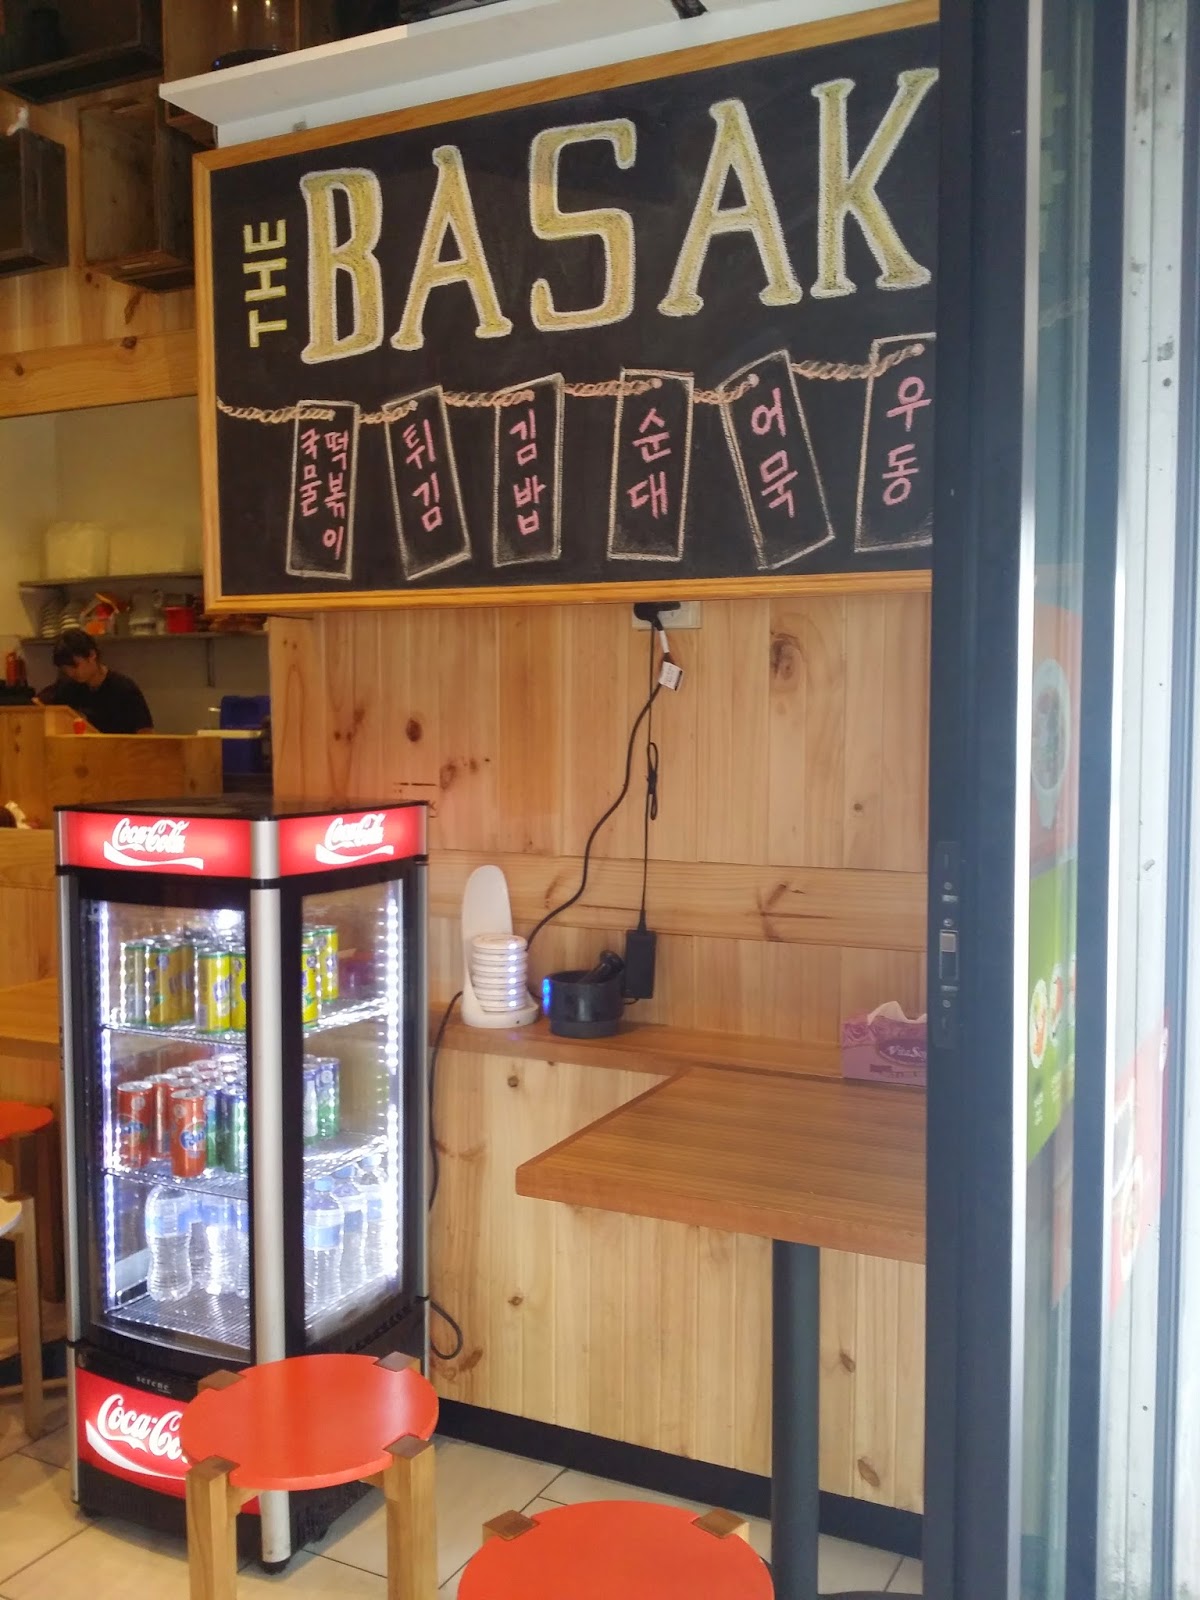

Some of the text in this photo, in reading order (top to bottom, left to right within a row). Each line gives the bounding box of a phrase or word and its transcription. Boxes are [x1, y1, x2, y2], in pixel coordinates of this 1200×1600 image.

[243, 68, 939, 364] THE BASAK
[299, 427, 322, 517] 국물
[323, 429, 349, 560] 떡볶이
[402, 418, 443, 532] 튀김
[509, 408, 547, 535] 김밥
[626, 407, 672, 519] 순대
[751, 387, 798, 518] 어묵
[884, 376, 932, 506] 우동
[111, 817, 190, 854] Coca-Cola
[97, 1393, 188, 1464] Coca-Co
